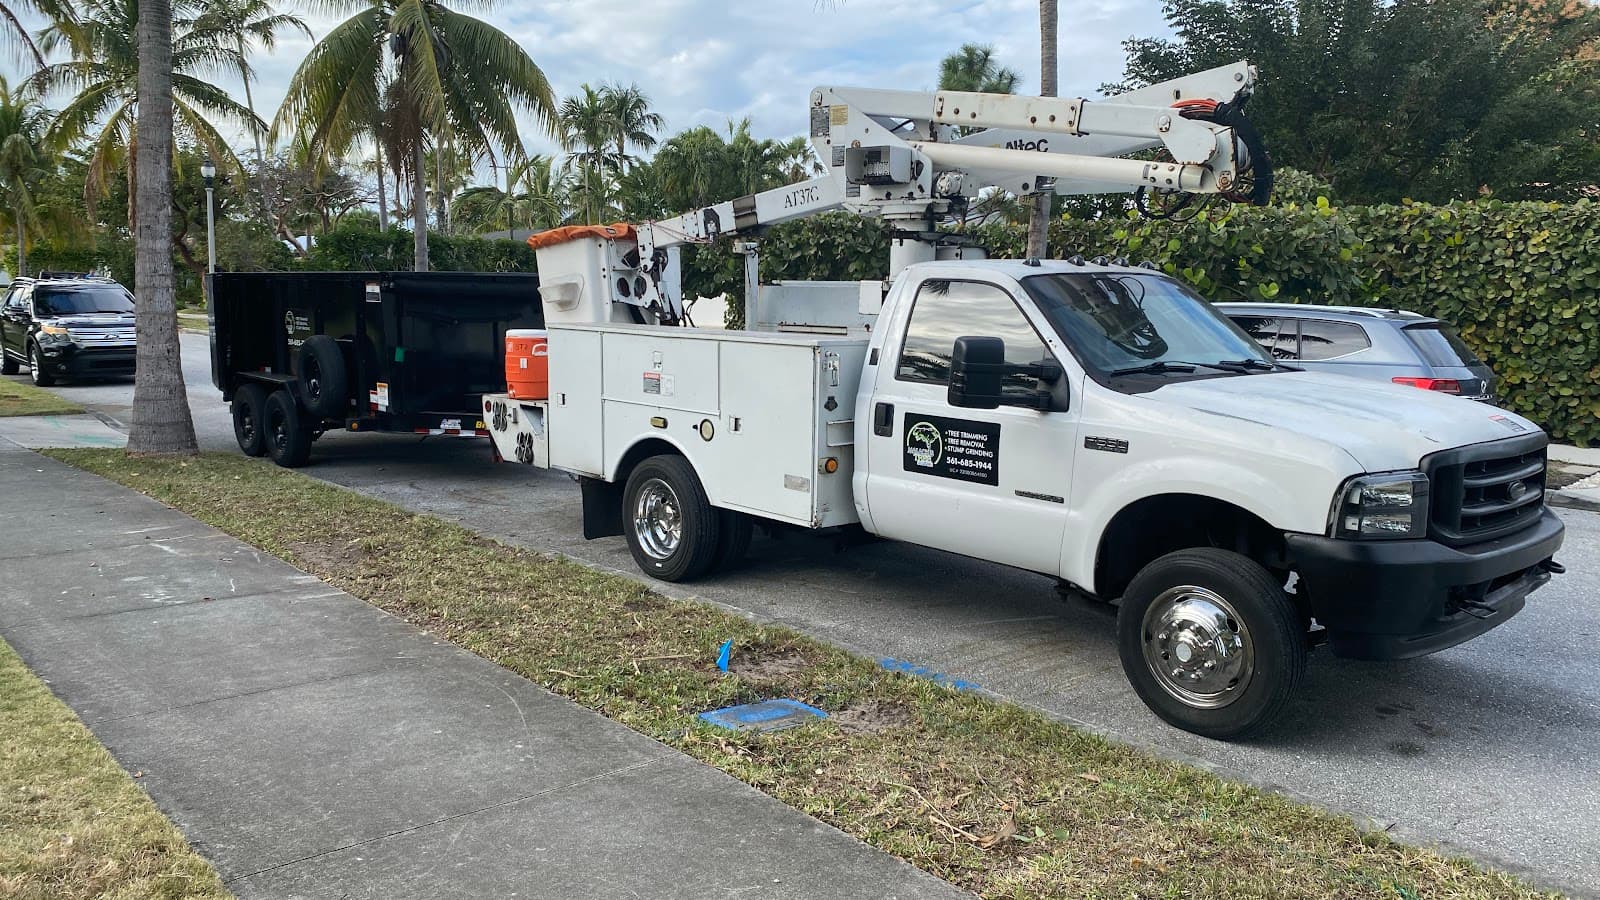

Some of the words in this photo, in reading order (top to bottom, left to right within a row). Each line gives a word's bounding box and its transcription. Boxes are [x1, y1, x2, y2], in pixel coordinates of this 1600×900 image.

[948, 430, 960, 438] TREE
[960, 431, 988, 441] TRIMMING
[947, 437, 960, 446] TREE
[960, 439, 986, 449] REMOVAL
[947, 445, 965, 454] STUMP
[965, 448, 994, 458] GRINDING
[946, 456, 993, 471] 561-685-1944
